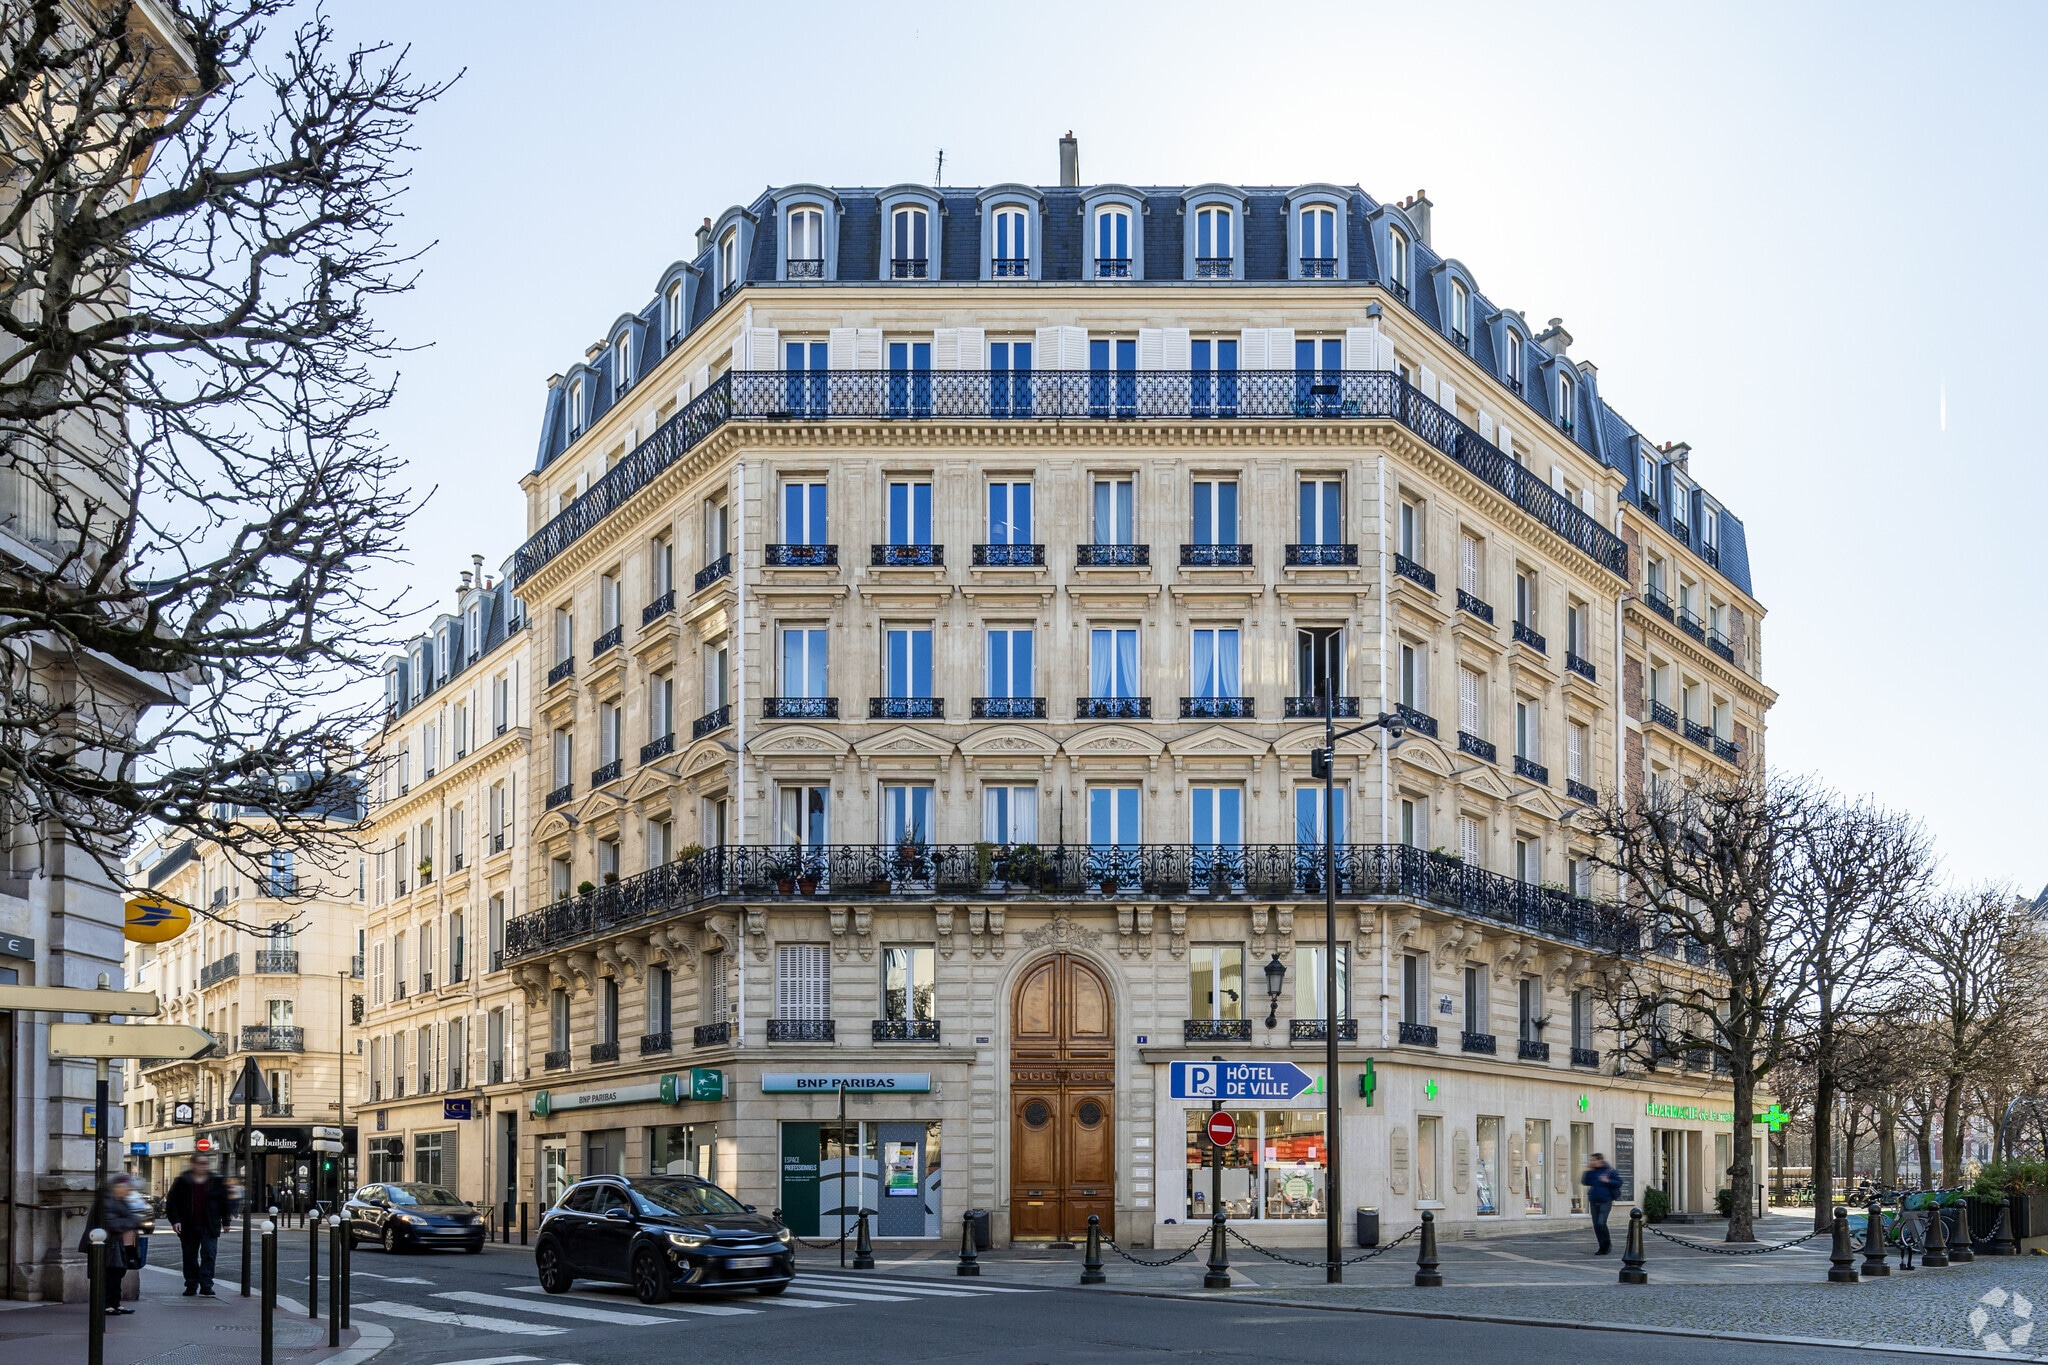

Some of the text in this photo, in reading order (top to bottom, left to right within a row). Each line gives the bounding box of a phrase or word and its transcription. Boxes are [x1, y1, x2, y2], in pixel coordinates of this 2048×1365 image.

[0, 936, 21, 952] E
[797, 1079, 895, 1088] BNP PARIBAS
[1192, 1064, 1275, 1093] P HÔTEL
[1226, 1083, 1246, 1095] DE
[1250, 1083, 1289, 1095] VILLE
[578, 1092, 617, 1104] BNP PARIBAS
[446, 1103, 465, 1111] LCL
[1646, 1102, 1698, 1120] PHARMACIE
[265, 1138, 298, 1149] building
